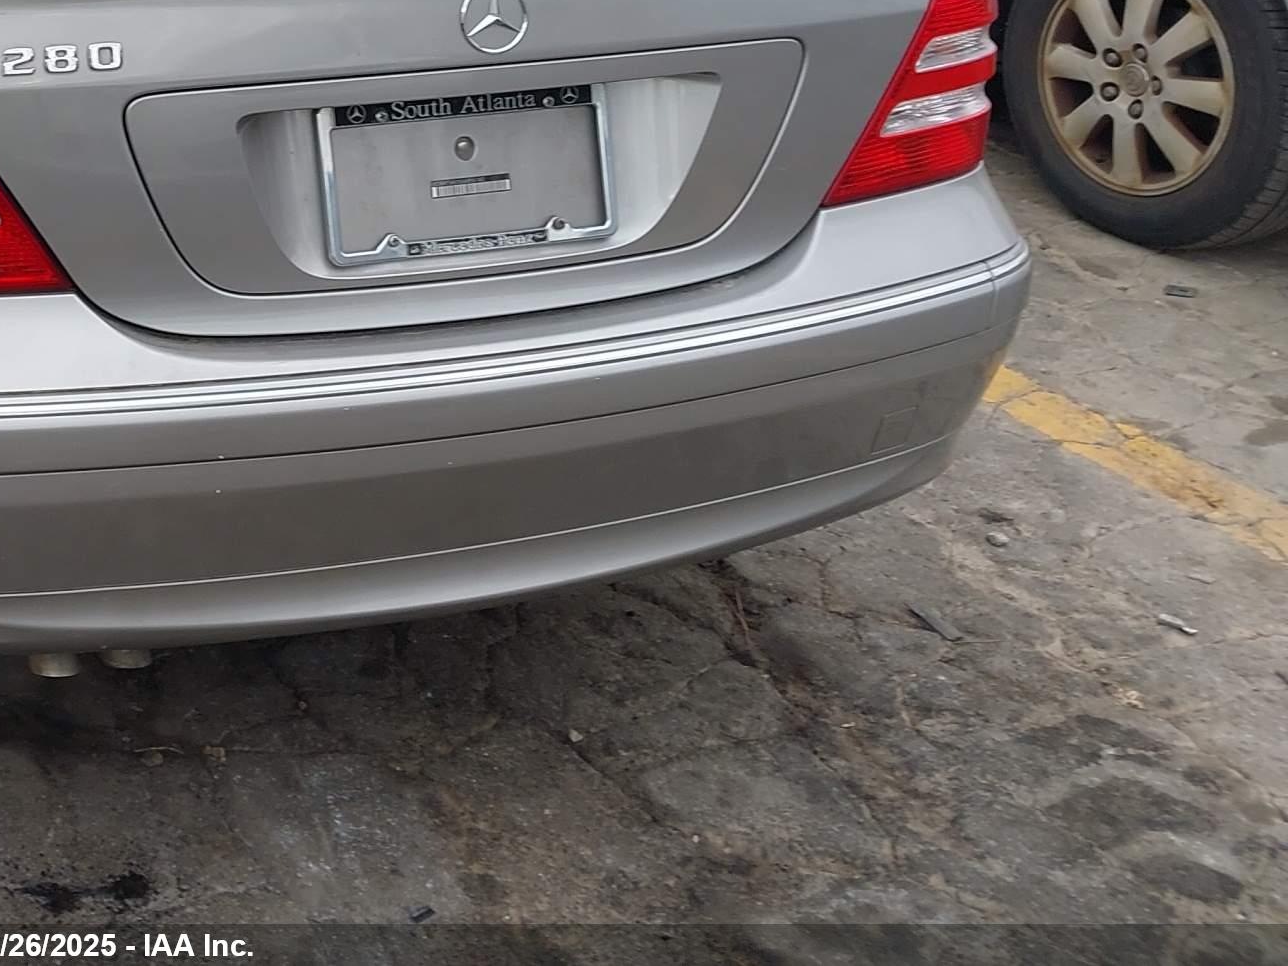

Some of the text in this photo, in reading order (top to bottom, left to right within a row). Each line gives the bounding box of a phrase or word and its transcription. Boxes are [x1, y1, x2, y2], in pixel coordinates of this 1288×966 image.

[2, 41, 123, 77] 280
[391, 93, 536, 121] South Atlanta
